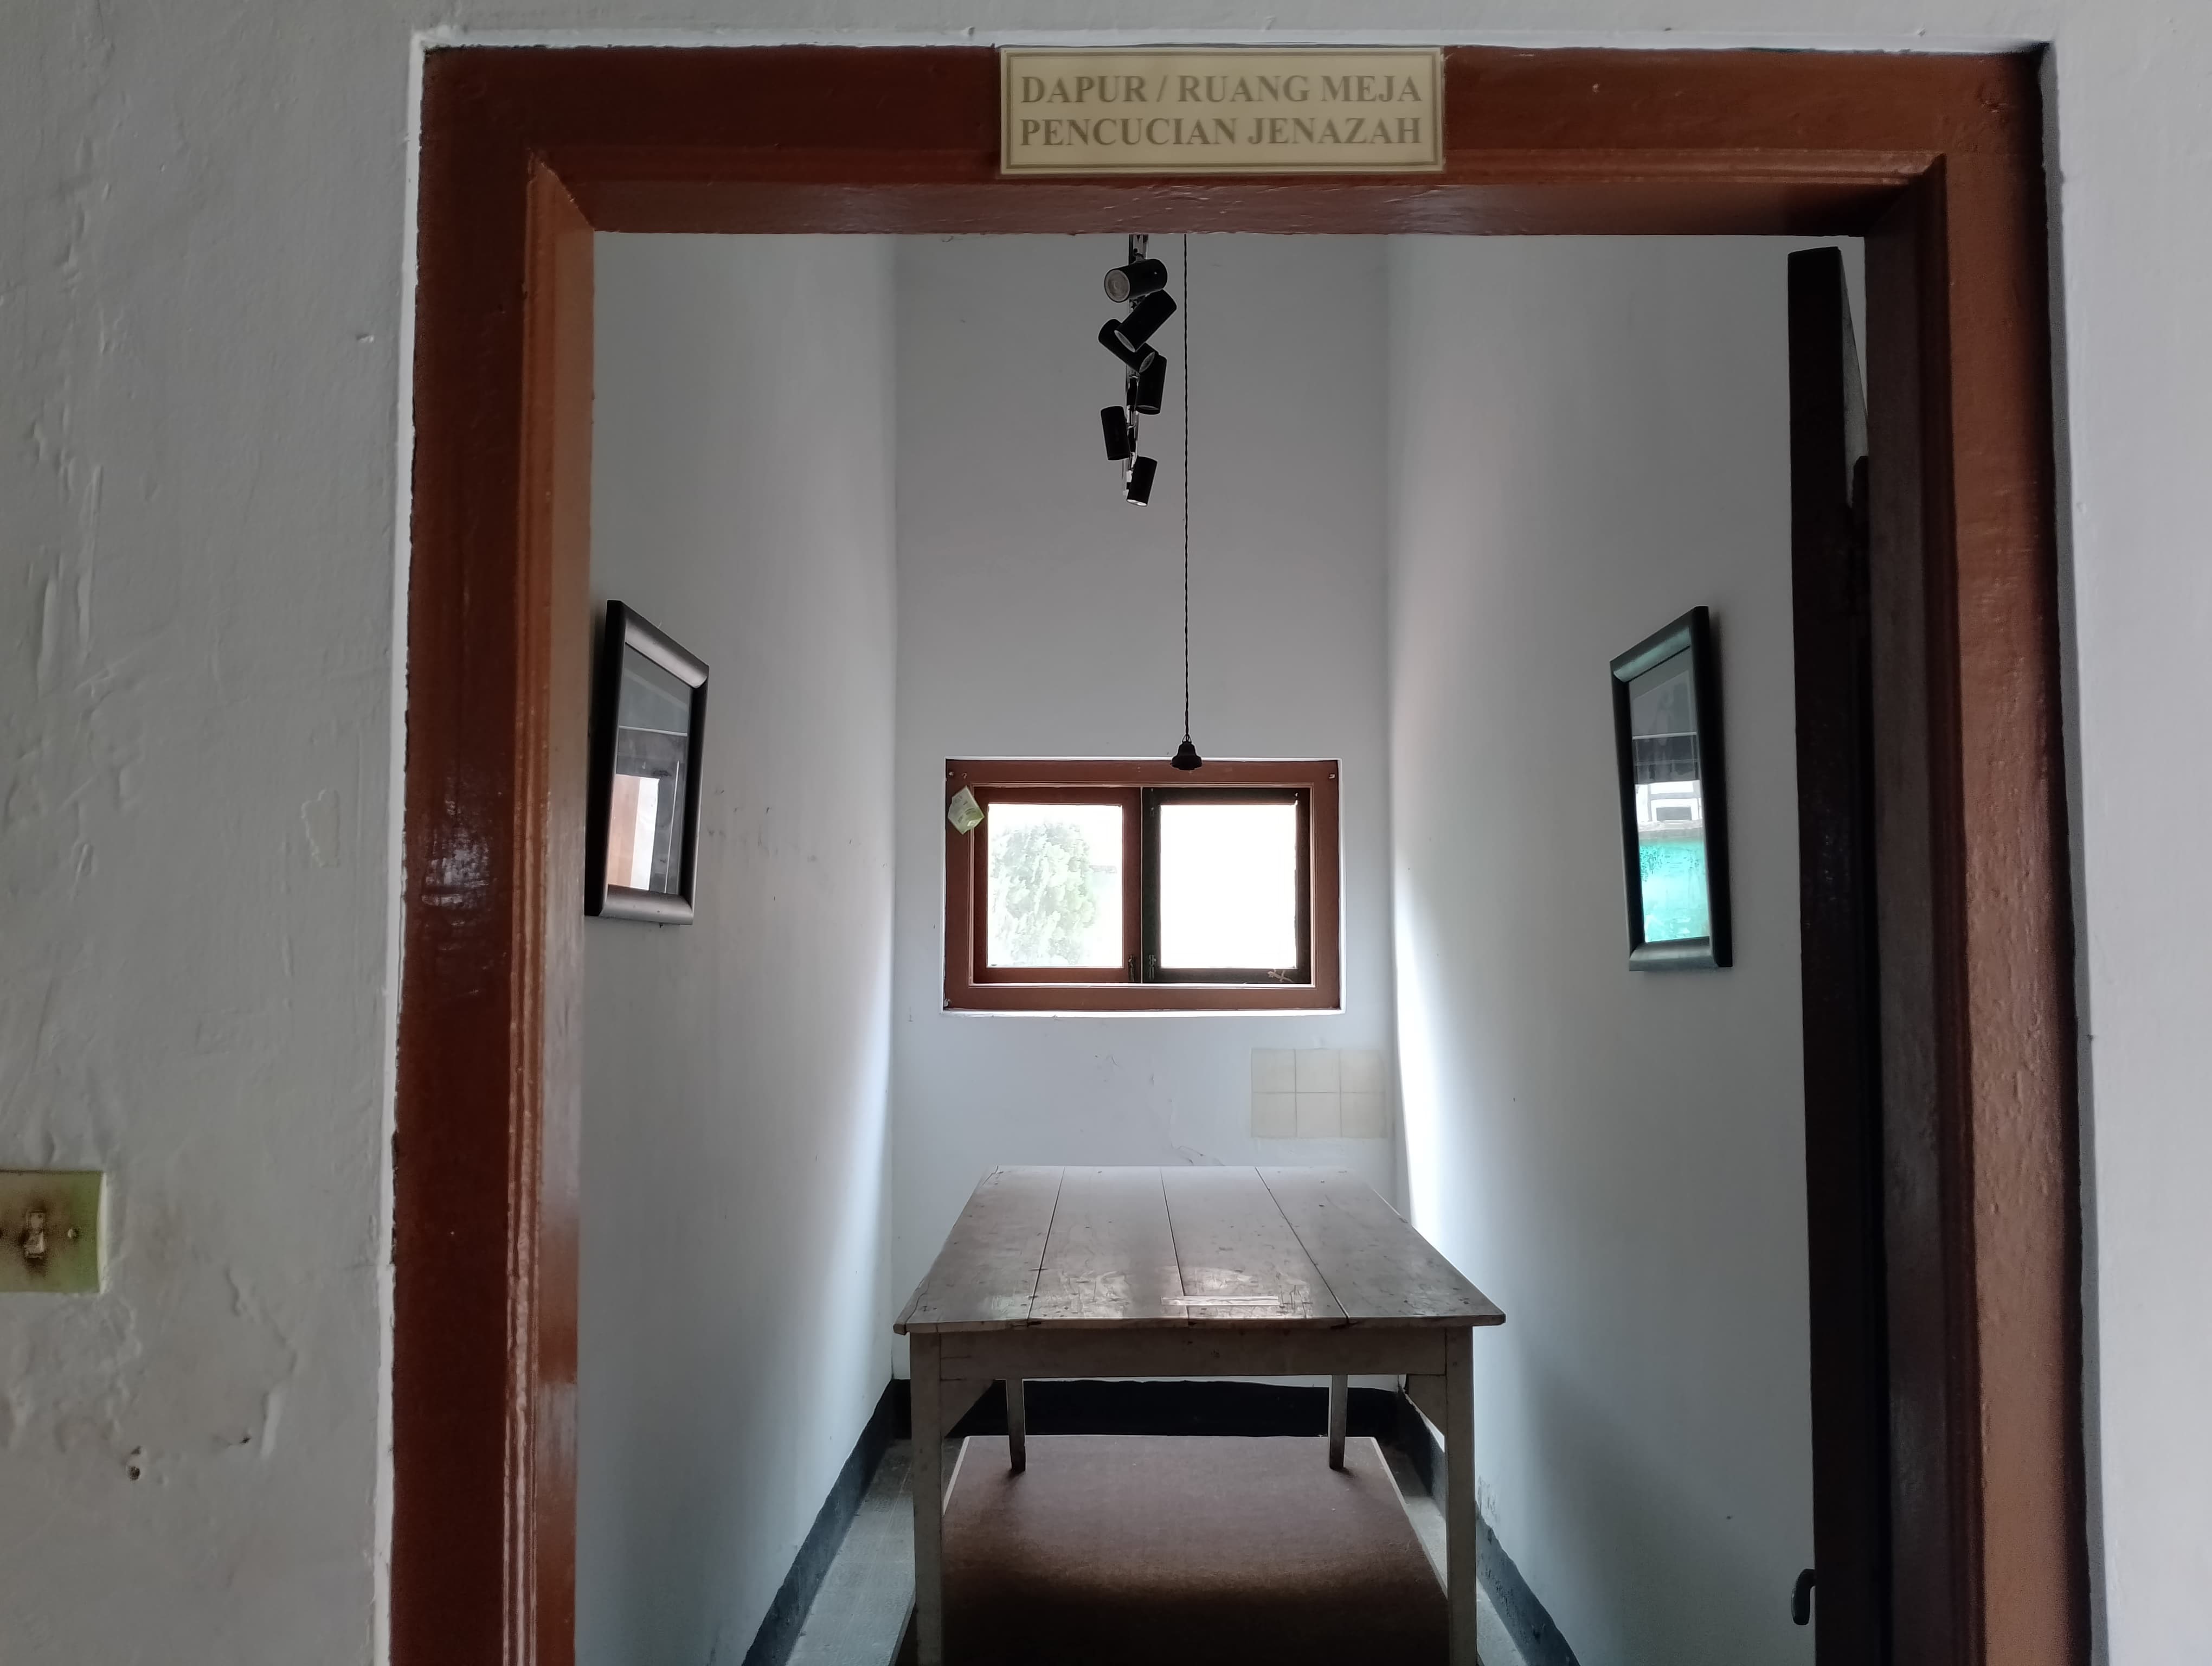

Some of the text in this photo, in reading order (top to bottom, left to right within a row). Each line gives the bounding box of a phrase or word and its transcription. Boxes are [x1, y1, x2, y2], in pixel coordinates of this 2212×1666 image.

[1021, 75, 1147, 103] DAPUR
[1178, 75, 1309, 102] RUANG
[1321, 75, 1422, 102] MEJA
[1020, 117, 1421, 146] PENCUCIAN JENAZAH
